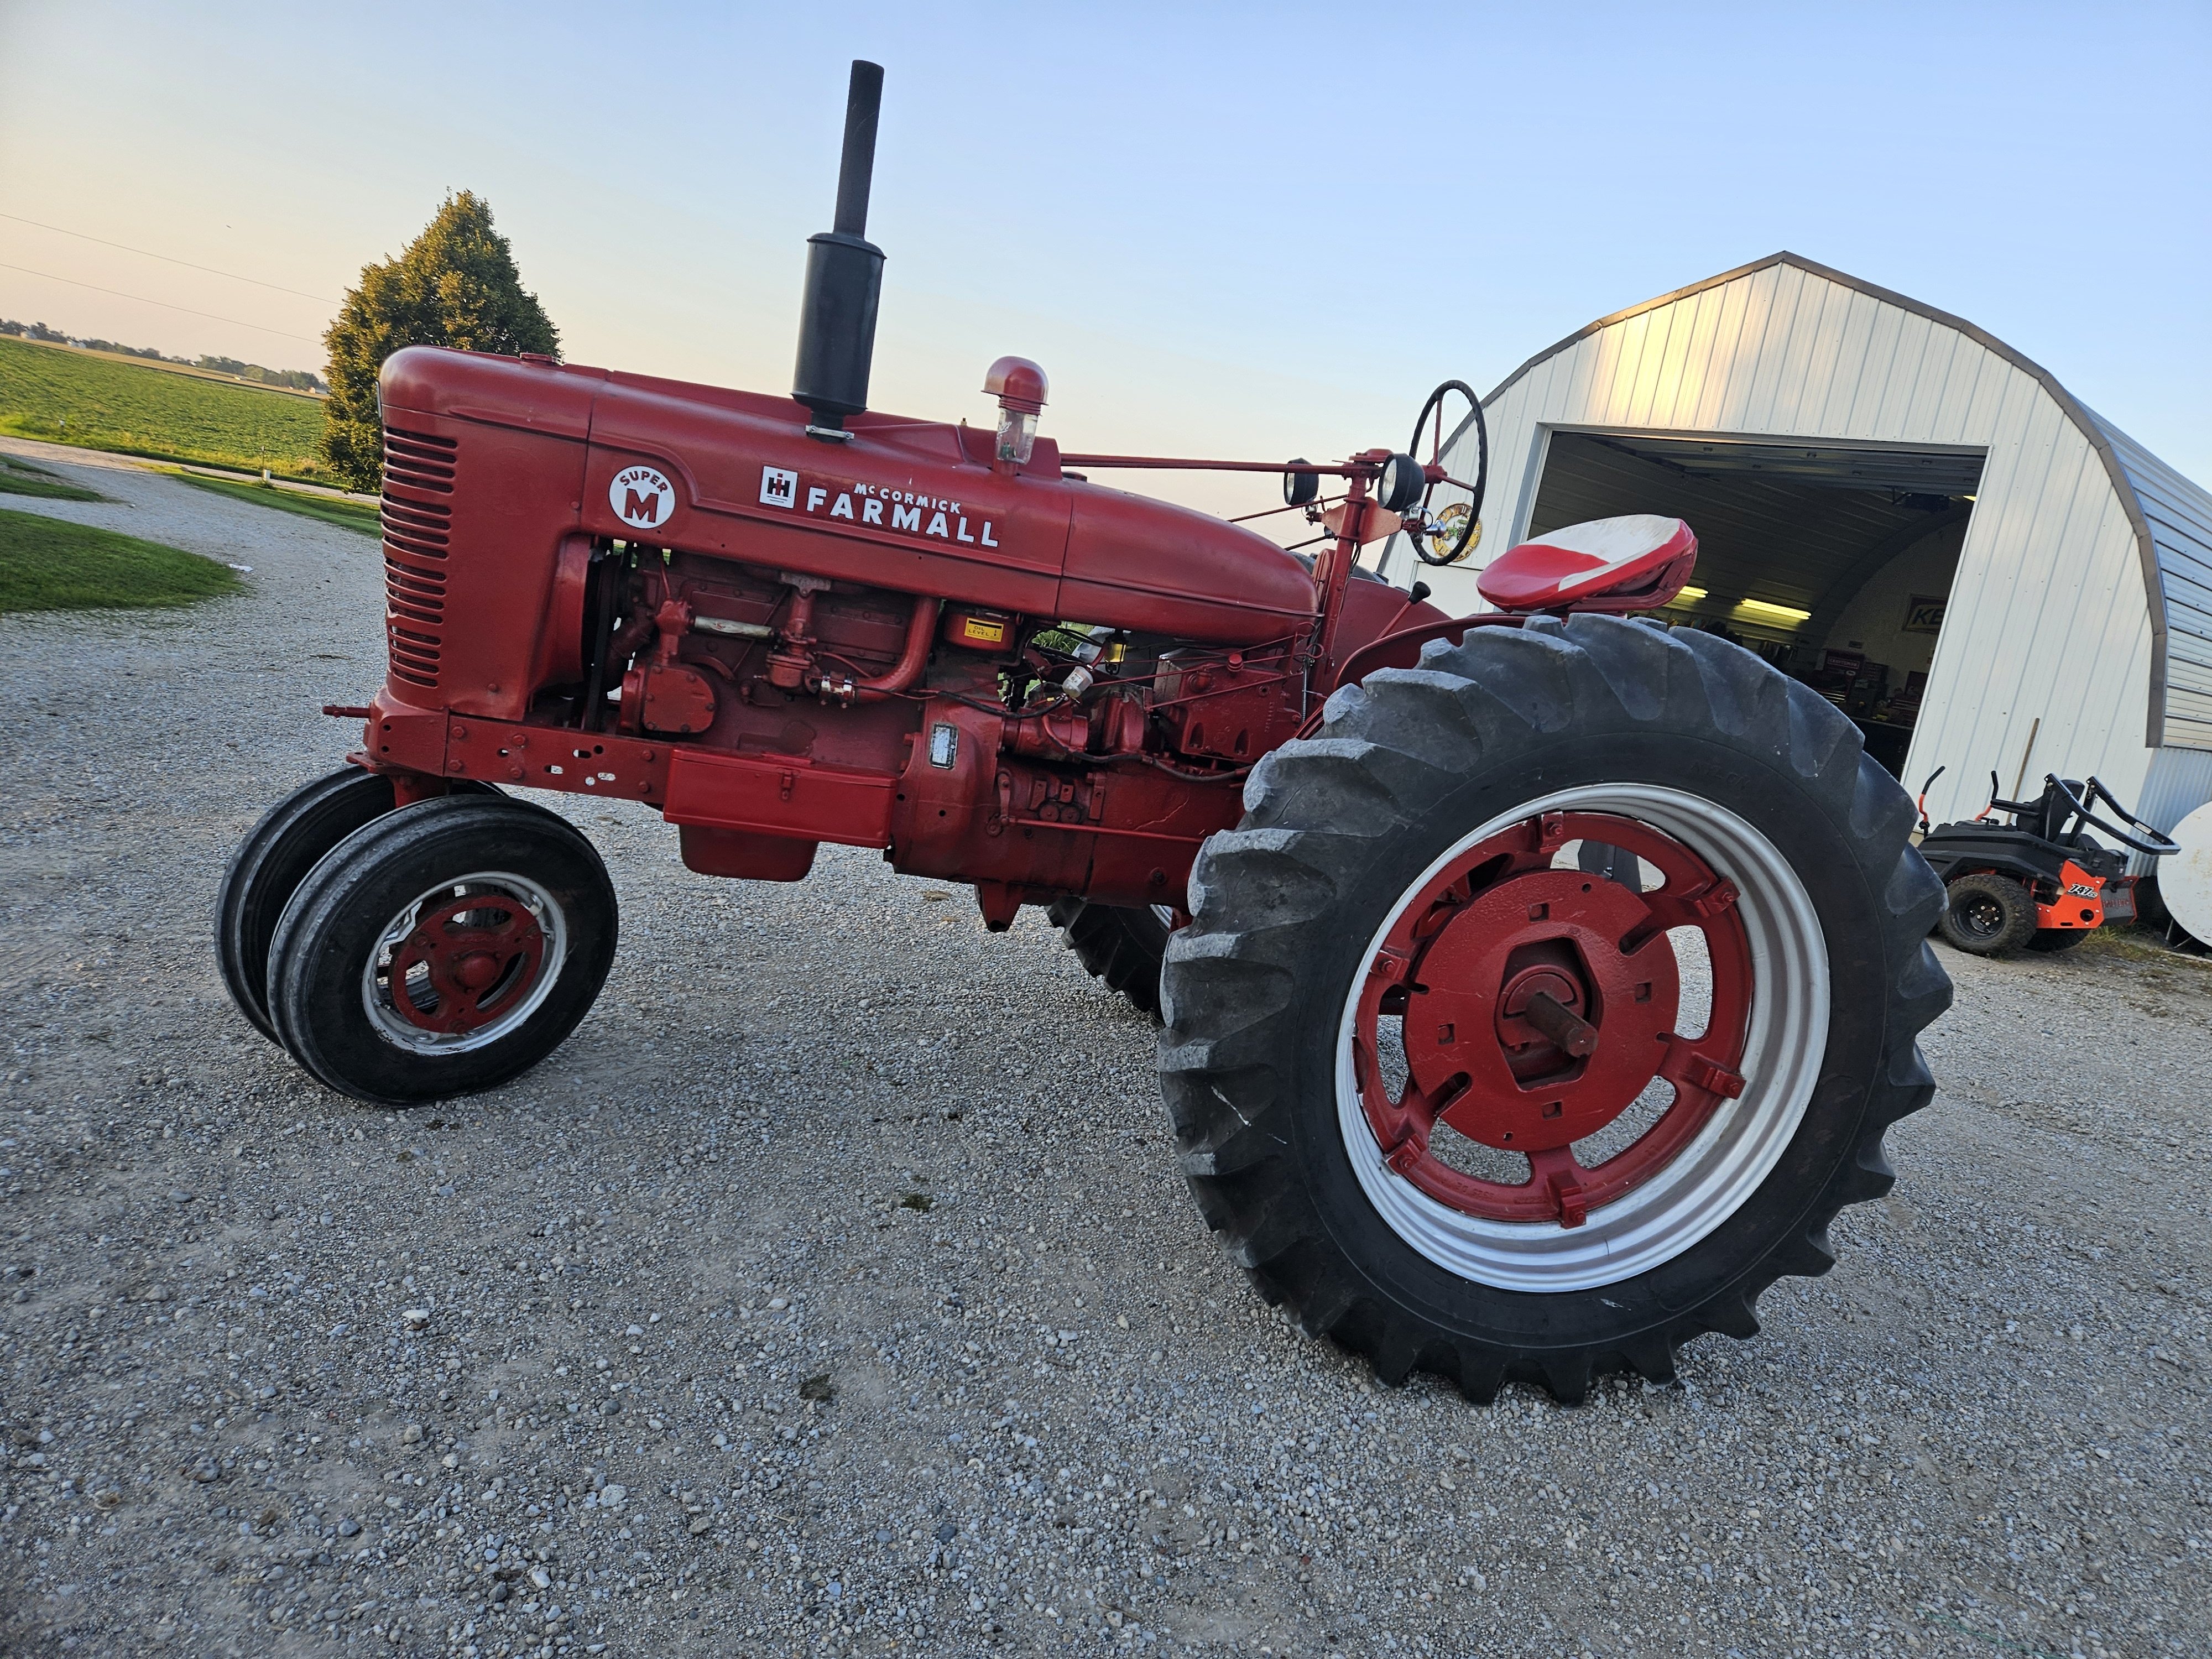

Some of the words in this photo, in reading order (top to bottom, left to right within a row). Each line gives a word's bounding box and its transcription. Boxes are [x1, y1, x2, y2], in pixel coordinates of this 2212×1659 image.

[619, 471, 668, 493] SUPER
[624, 488, 659, 523] M
[806, 487, 999, 547] FARMALL
